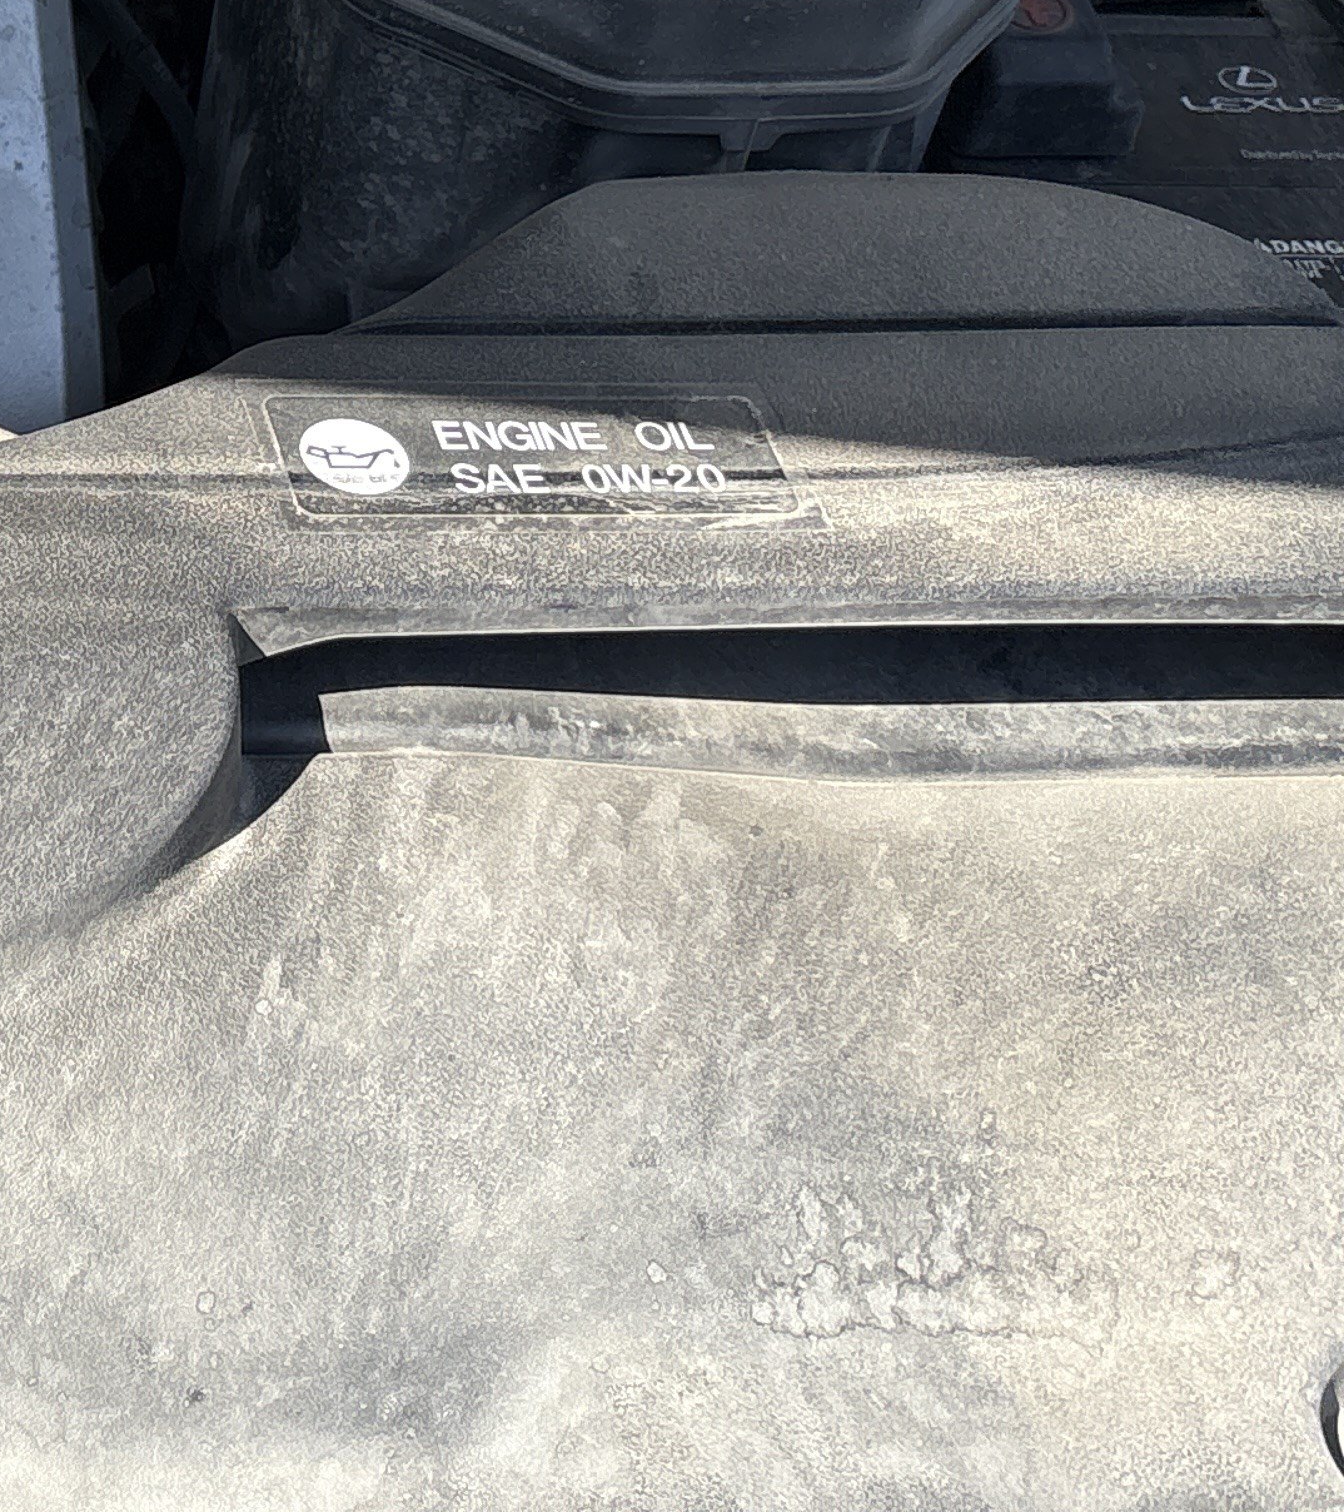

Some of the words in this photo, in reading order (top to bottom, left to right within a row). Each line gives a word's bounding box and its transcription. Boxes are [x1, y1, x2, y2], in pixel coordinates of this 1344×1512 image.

[1180, 95, 1344, 113] LEXUS
[1269, 239, 1344, 255] DANG
[431, 420, 608, 451] ENGINE
[633, 421, 715, 451] OIL
[450, 462, 552, 494] SAE
[580, 463, 726, 494] 0W-20
